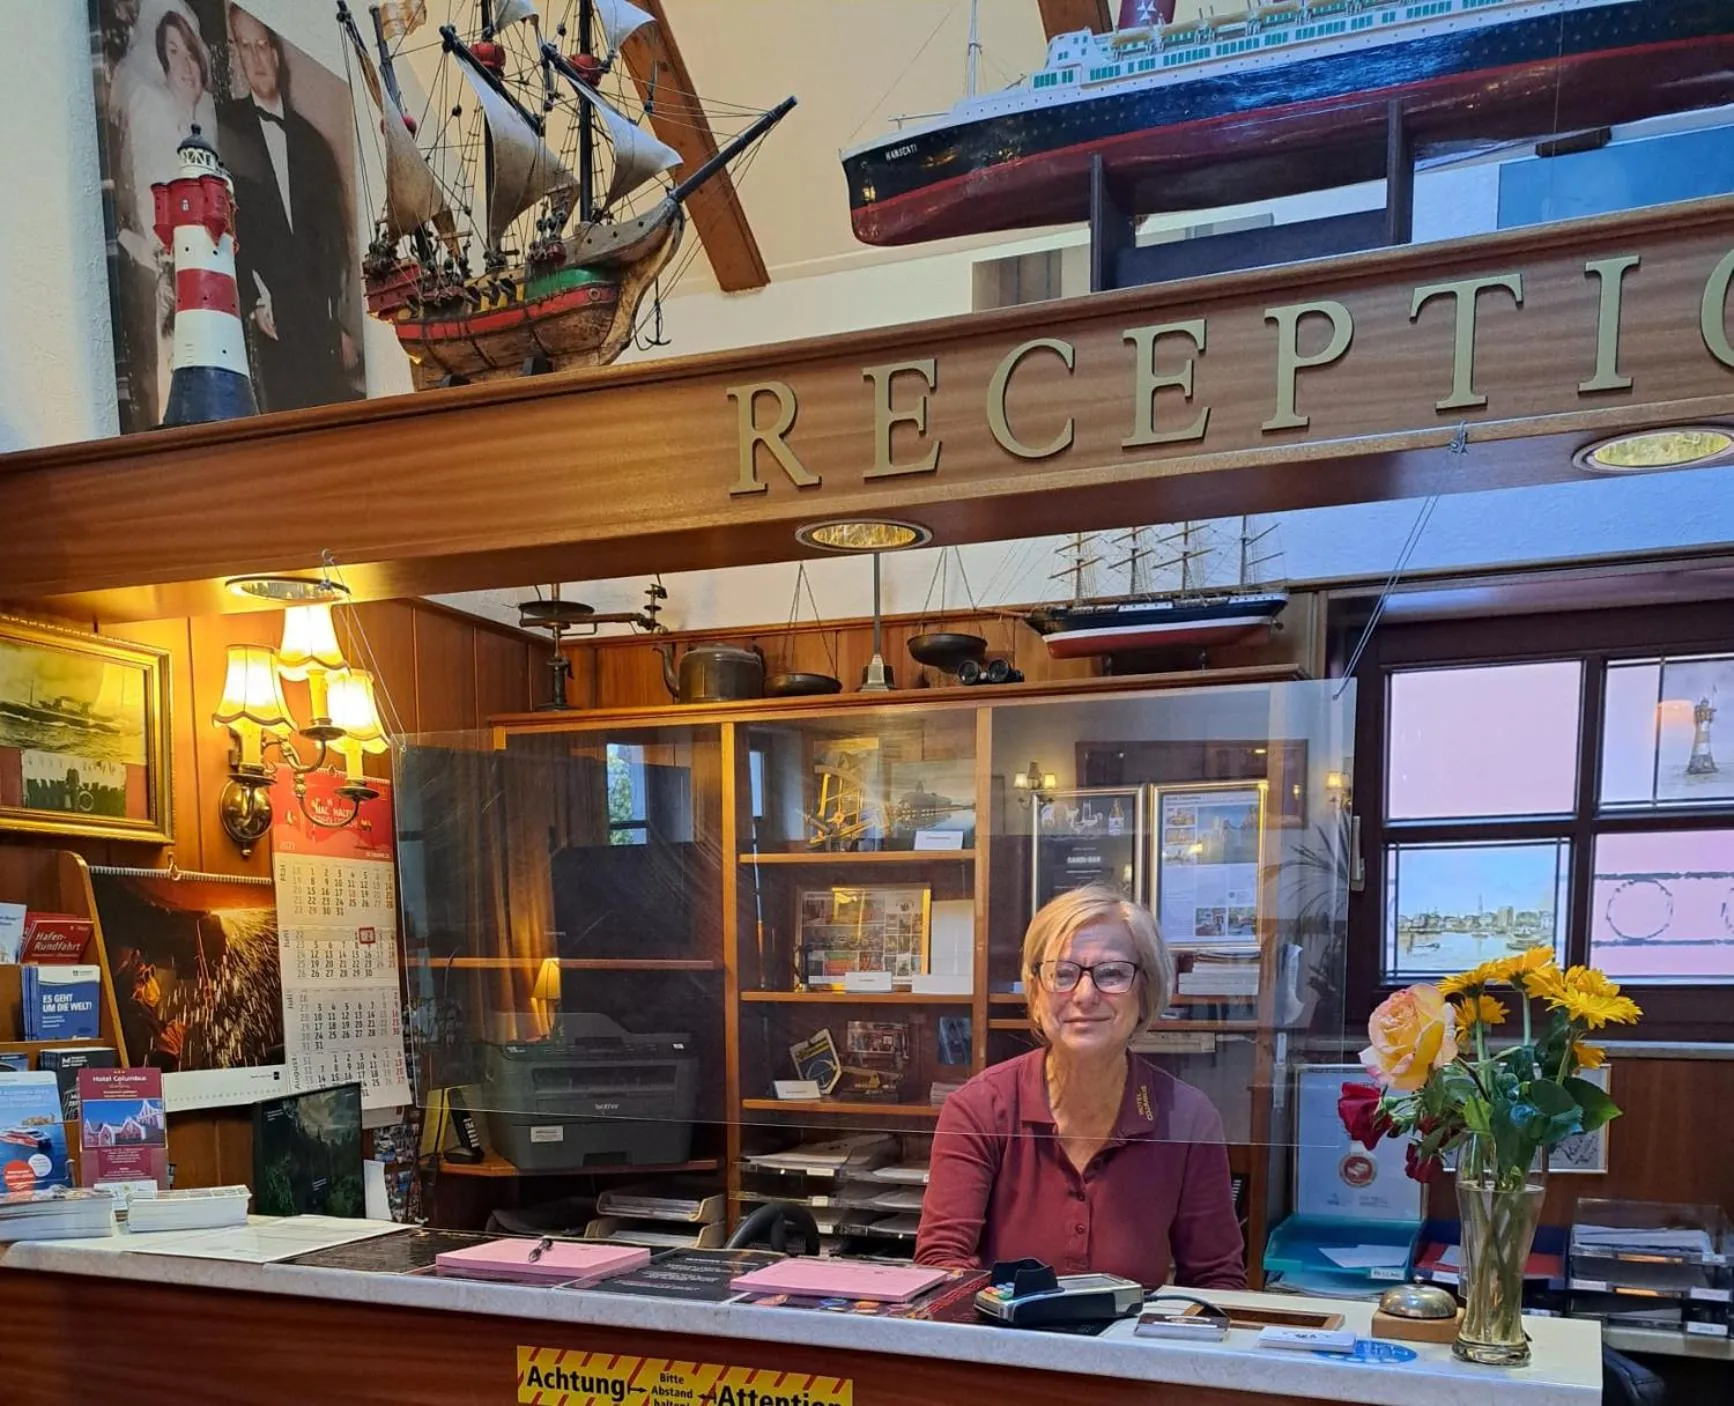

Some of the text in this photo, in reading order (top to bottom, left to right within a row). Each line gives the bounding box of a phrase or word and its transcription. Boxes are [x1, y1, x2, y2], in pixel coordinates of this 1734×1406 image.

[36, 931, 67, 941] Hafen-
[34, 942, 81, 951] Rundfahrt
[43, 993, 73, 1004] ES GEHT
[43, 1003, 56, 1013] UM
[57, 1002, 70, 1012] DIE
[527, 1365, 625, 1402] Achtung
[660, 1372, 685, 1385] Bitte
[651, 1385, 693, 1399] Abstand
